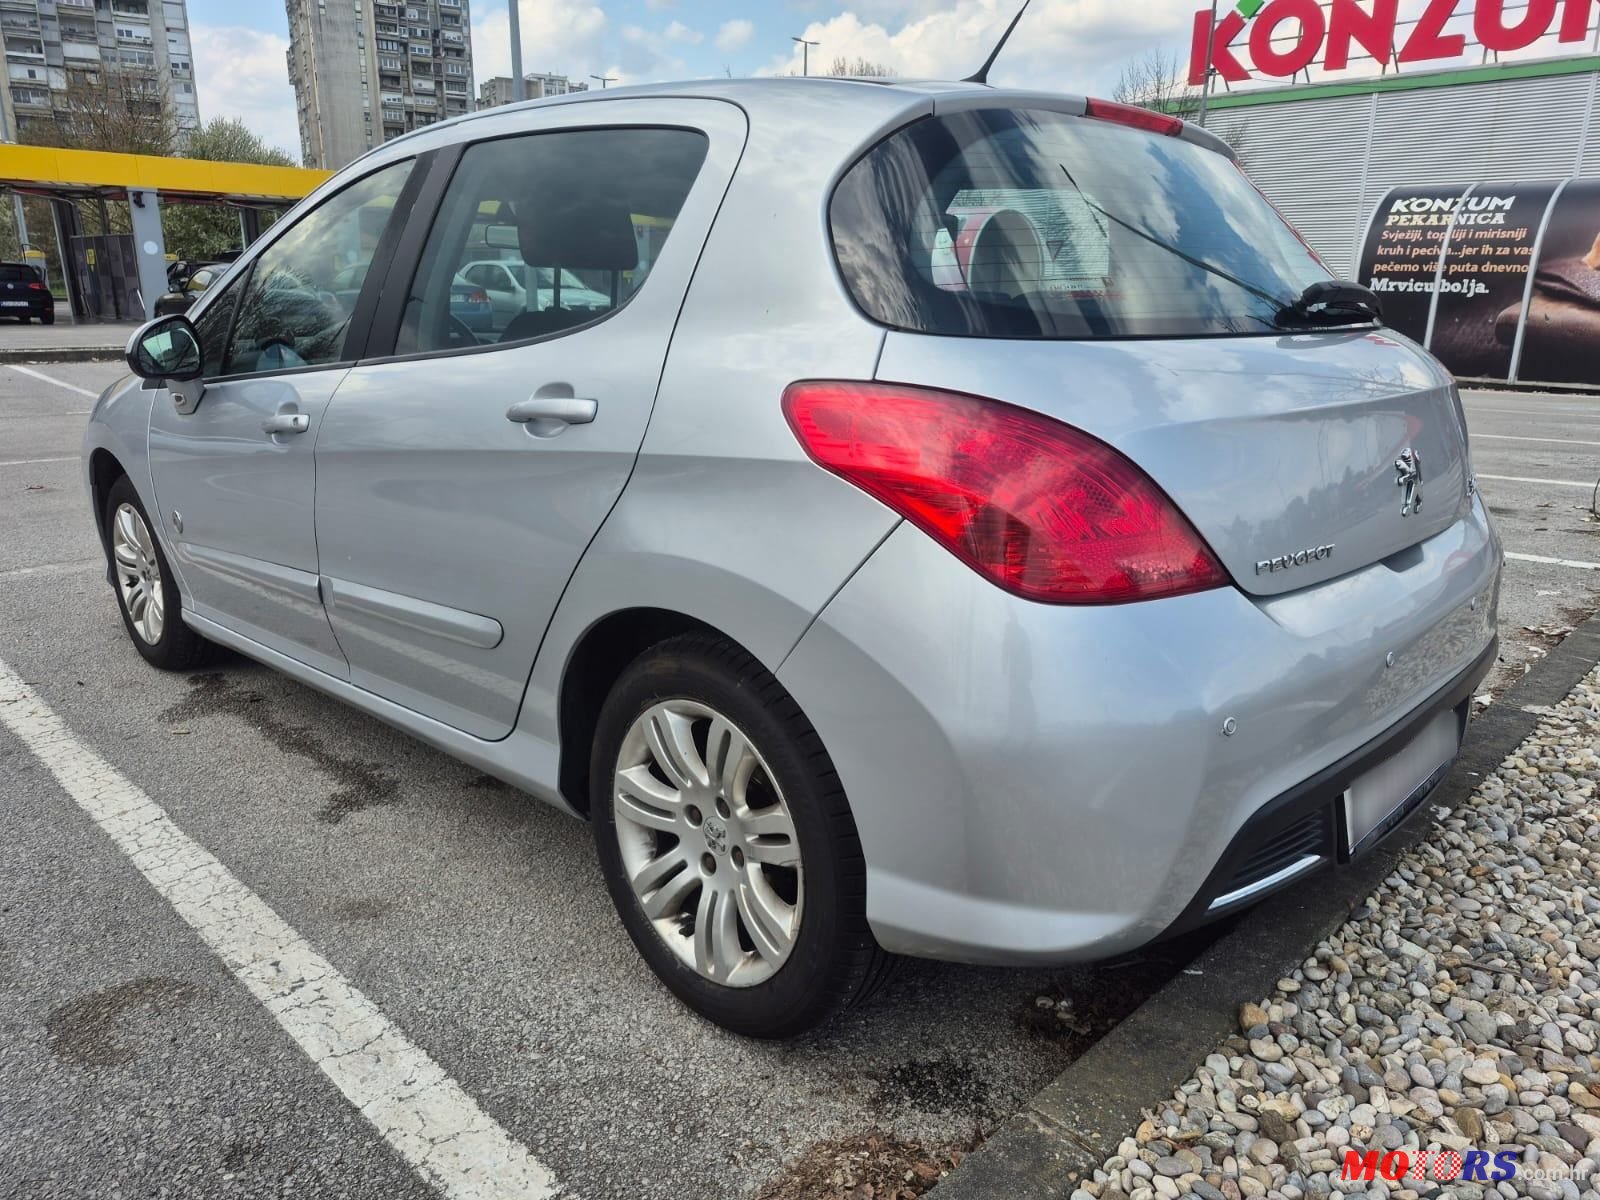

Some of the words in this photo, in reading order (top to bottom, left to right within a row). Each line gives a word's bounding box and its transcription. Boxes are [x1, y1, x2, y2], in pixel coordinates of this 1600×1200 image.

[1390, 196, 1516, 213] KONZUM
[1385, 213, 1506, 226] PEKARNICA
[1381, 229, 1423, 242] Svježiji,
[1468, 229, 1474, 239] i
[1475, 228, 1527, 241] mirisniji
[1377, 245, 1403, 255] kruh
[1406, 245, 1411, 255] i
[1481, 244, 1493, 255] ih
[1495, 247, 1510, 255] za
[1513, 246, 1536, 255] vas
[1373, 261, 1419, 274] pečemo
[1423, 262, 1447, 272] više
[1449, 262, 1478, 275] puta
[1481, 261, 1529, 273] dnevno
[1369, 277, 1434, 292] Mrvicu
[1440, 278, 1490, 298] bolja.
[1255, 543, 1335, 576] PEUGEOT
